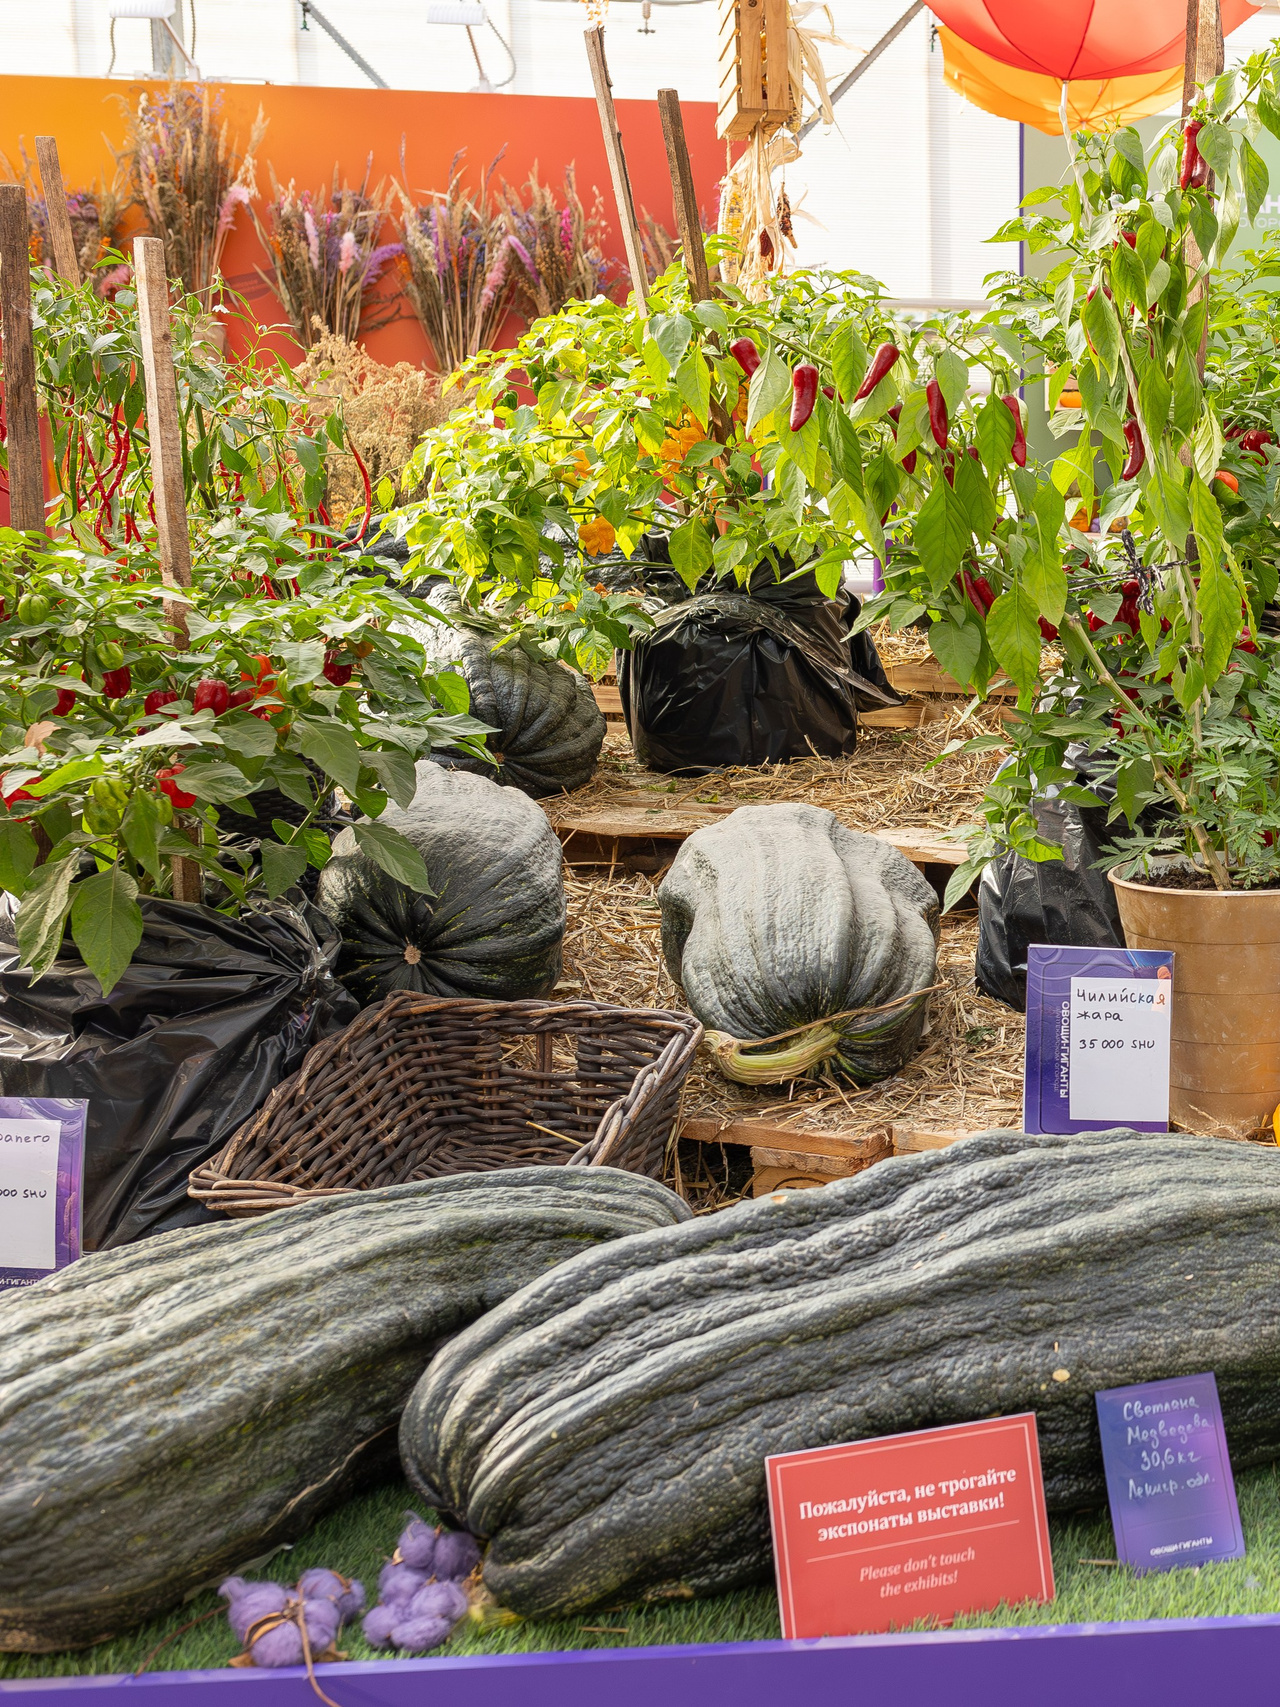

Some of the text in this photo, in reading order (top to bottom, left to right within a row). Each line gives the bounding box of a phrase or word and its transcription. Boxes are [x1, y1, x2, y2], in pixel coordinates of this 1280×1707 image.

[1077, 987, 1166, 1006] Чилийская
[1060, 1001, 1070, 1099] ОВОЩИ-ГИГАНТЫ
[1079, 1039, 1155, 1050] 35 000 SHU
[22, 1189, 47, 1199] SHU
[1122, 1396, 1200, 1422] Светлана
[1126, 1413, 1214, 1449] Медведева
[799, 1467, 1016, 1520] Пожалуйста, не трогайте
[817, 1491, 1005, 1542] экспонаты выставки!
[859, 1563, 902, 1582] Please
[939, 1546, 976, 1566] touch
[879, 1569, 959, 1598] the exhibits!
